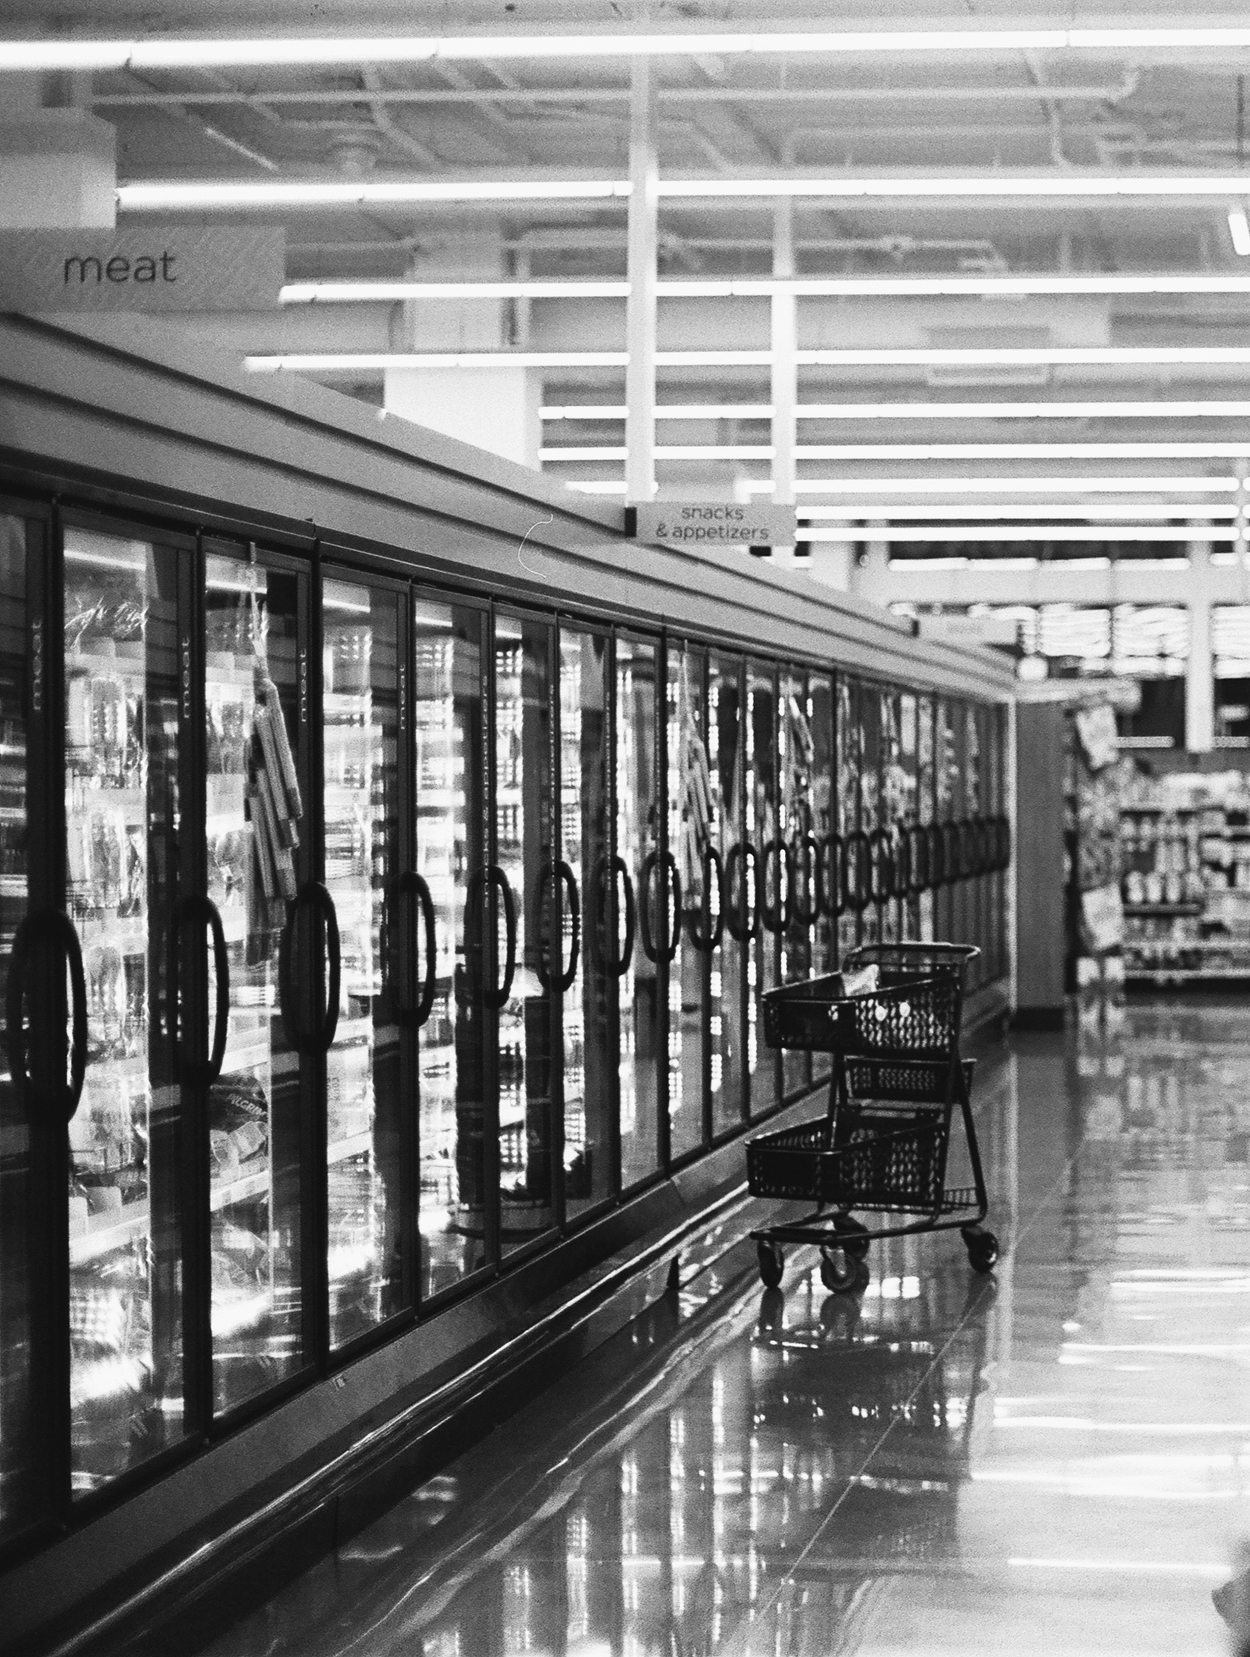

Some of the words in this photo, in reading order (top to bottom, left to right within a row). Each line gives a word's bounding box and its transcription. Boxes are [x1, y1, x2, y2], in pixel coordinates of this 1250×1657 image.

[64, 251, 177, 284] meat
[681, 506, 745, 520] snacks
[655, 523, 668, 538] &
[671, 524, 770, 541] appetizers
